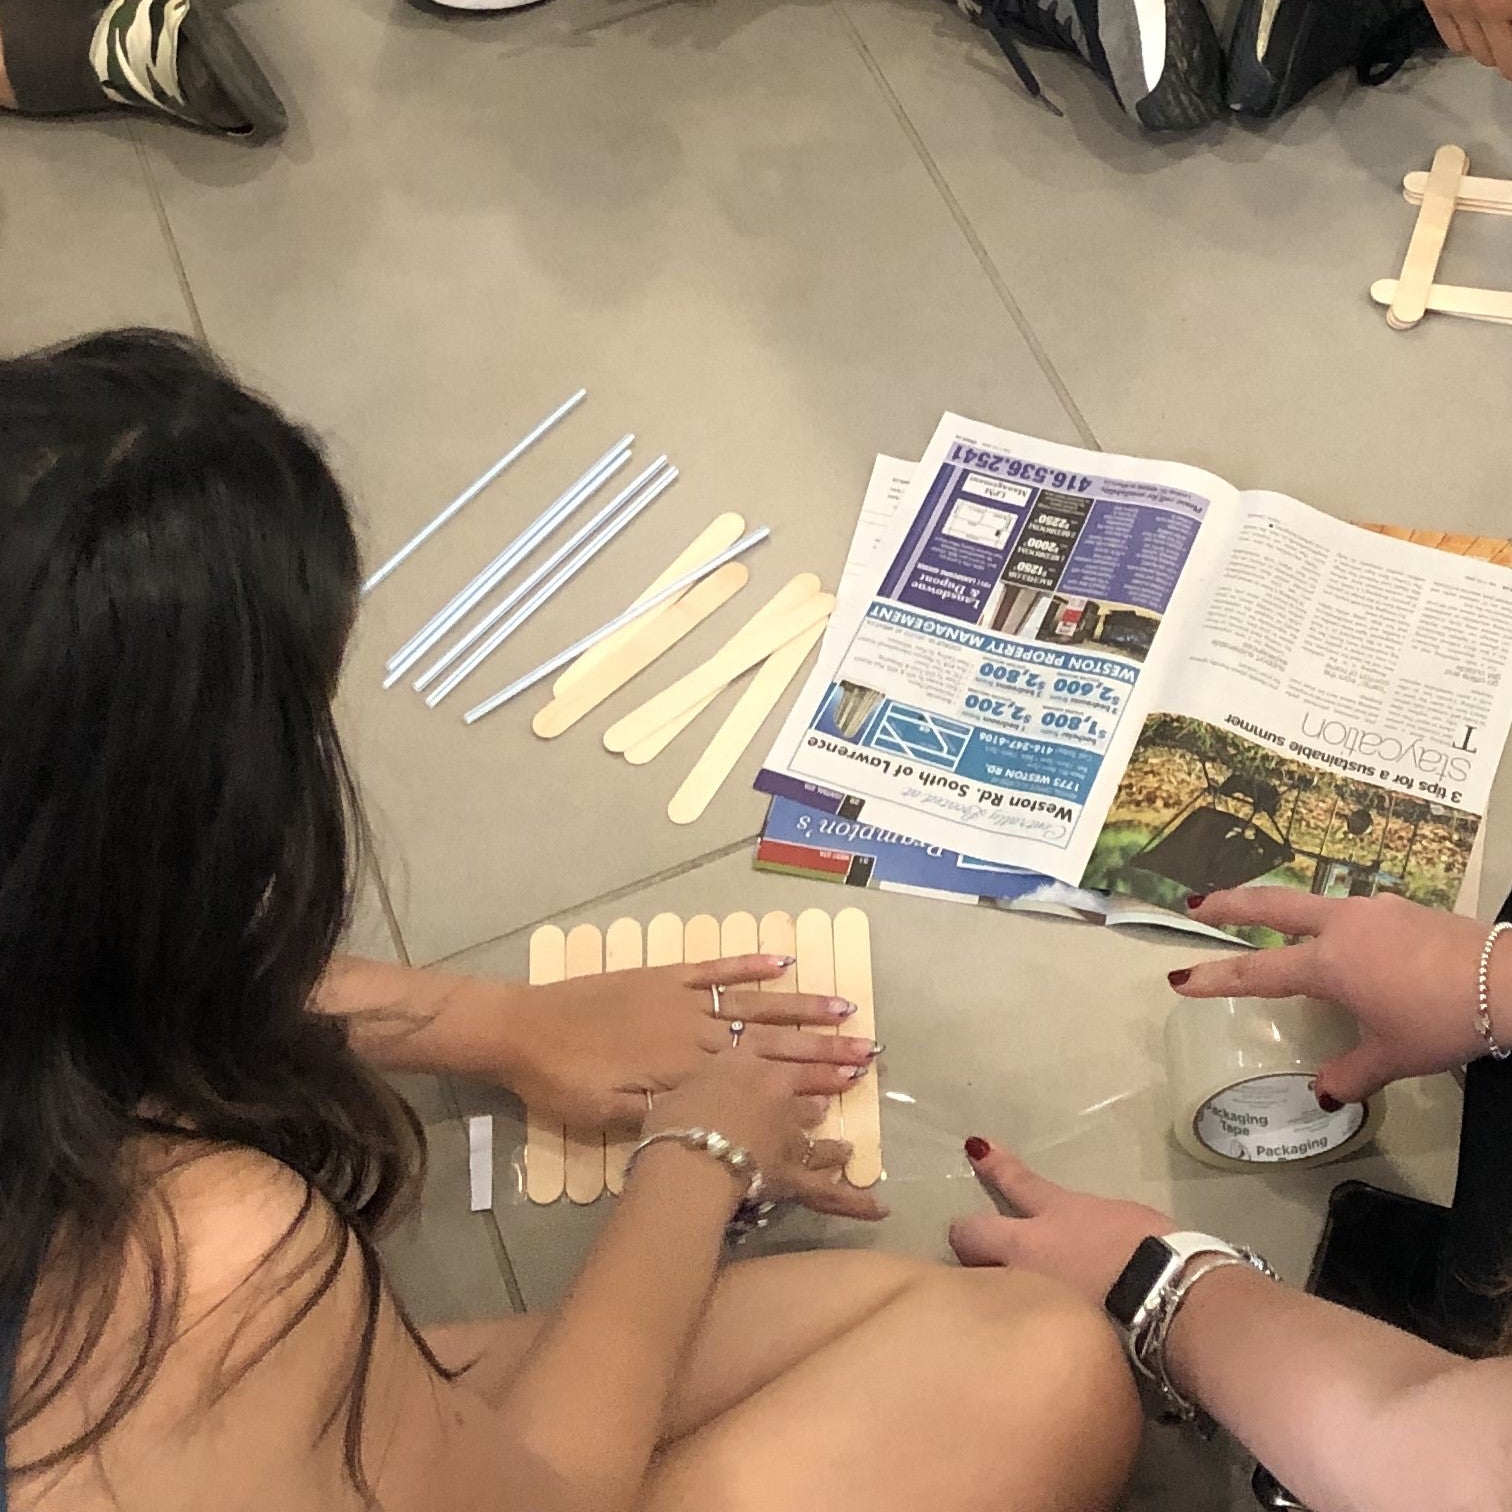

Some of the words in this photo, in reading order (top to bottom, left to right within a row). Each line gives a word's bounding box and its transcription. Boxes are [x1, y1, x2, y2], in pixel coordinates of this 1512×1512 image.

[951, 444, 1092, 495] 416.536.2541
[869, 604, 985, 647] MANAGEMENT
[986, 639, 1065, 666] PROPERTY
[1068, 655, 1135, 681] WESTON
[963, 692, 1031, 723] $2,200
[1040, 710, 1107, 739] $1,800
[1223, 713, 1285, 746] summer
[806, 735, 890, 774] Lawrence
[1288, 740, 1375, 775] sustainable
[1299, 711, 1472, 783] staycation
[892, 763, 913, 780] of
[983, 762, 1003, 775] RD.
[1005, 768, 1050, 783] WESTON
[1378, 769, 1390, 781] a
[1390, 772, 1414, 789] for
[917, 770, 970, 798] South
[974, 787, 1003, 807] Rd.
[1417, 779, 1447, 799] tips
[1449, 789, 1463, 803] 3
[1008, 795, 1073, 823] Weston
[1220, 1120, 1250, 1136] Tape
[1256, 1137, 1328, 1156] Packaging
